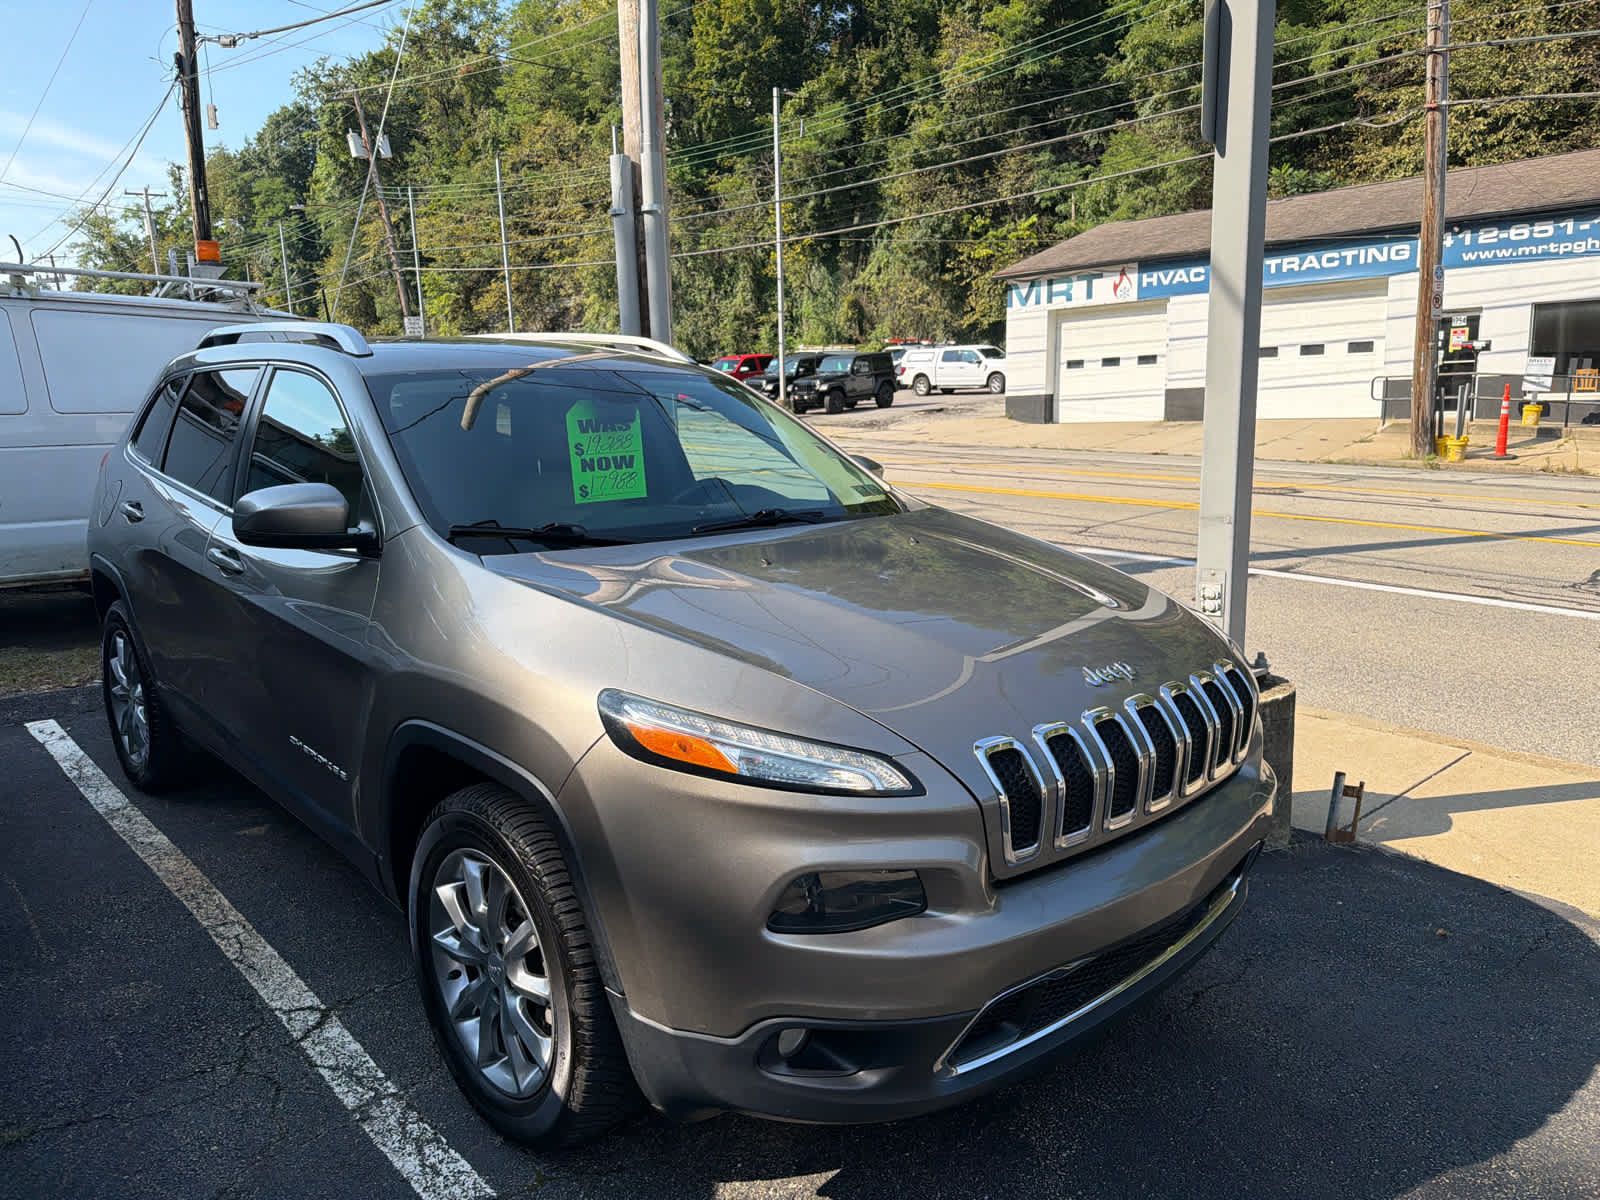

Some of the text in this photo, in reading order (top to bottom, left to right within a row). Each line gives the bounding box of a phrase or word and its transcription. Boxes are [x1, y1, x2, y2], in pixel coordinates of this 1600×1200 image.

[1142, 267, 1206, 288] HVAC
[1007, 272, 1104, 309] MRT
[580, 454, 635, 473] NOW
[1082, 660, 1137, 688] Jeep
